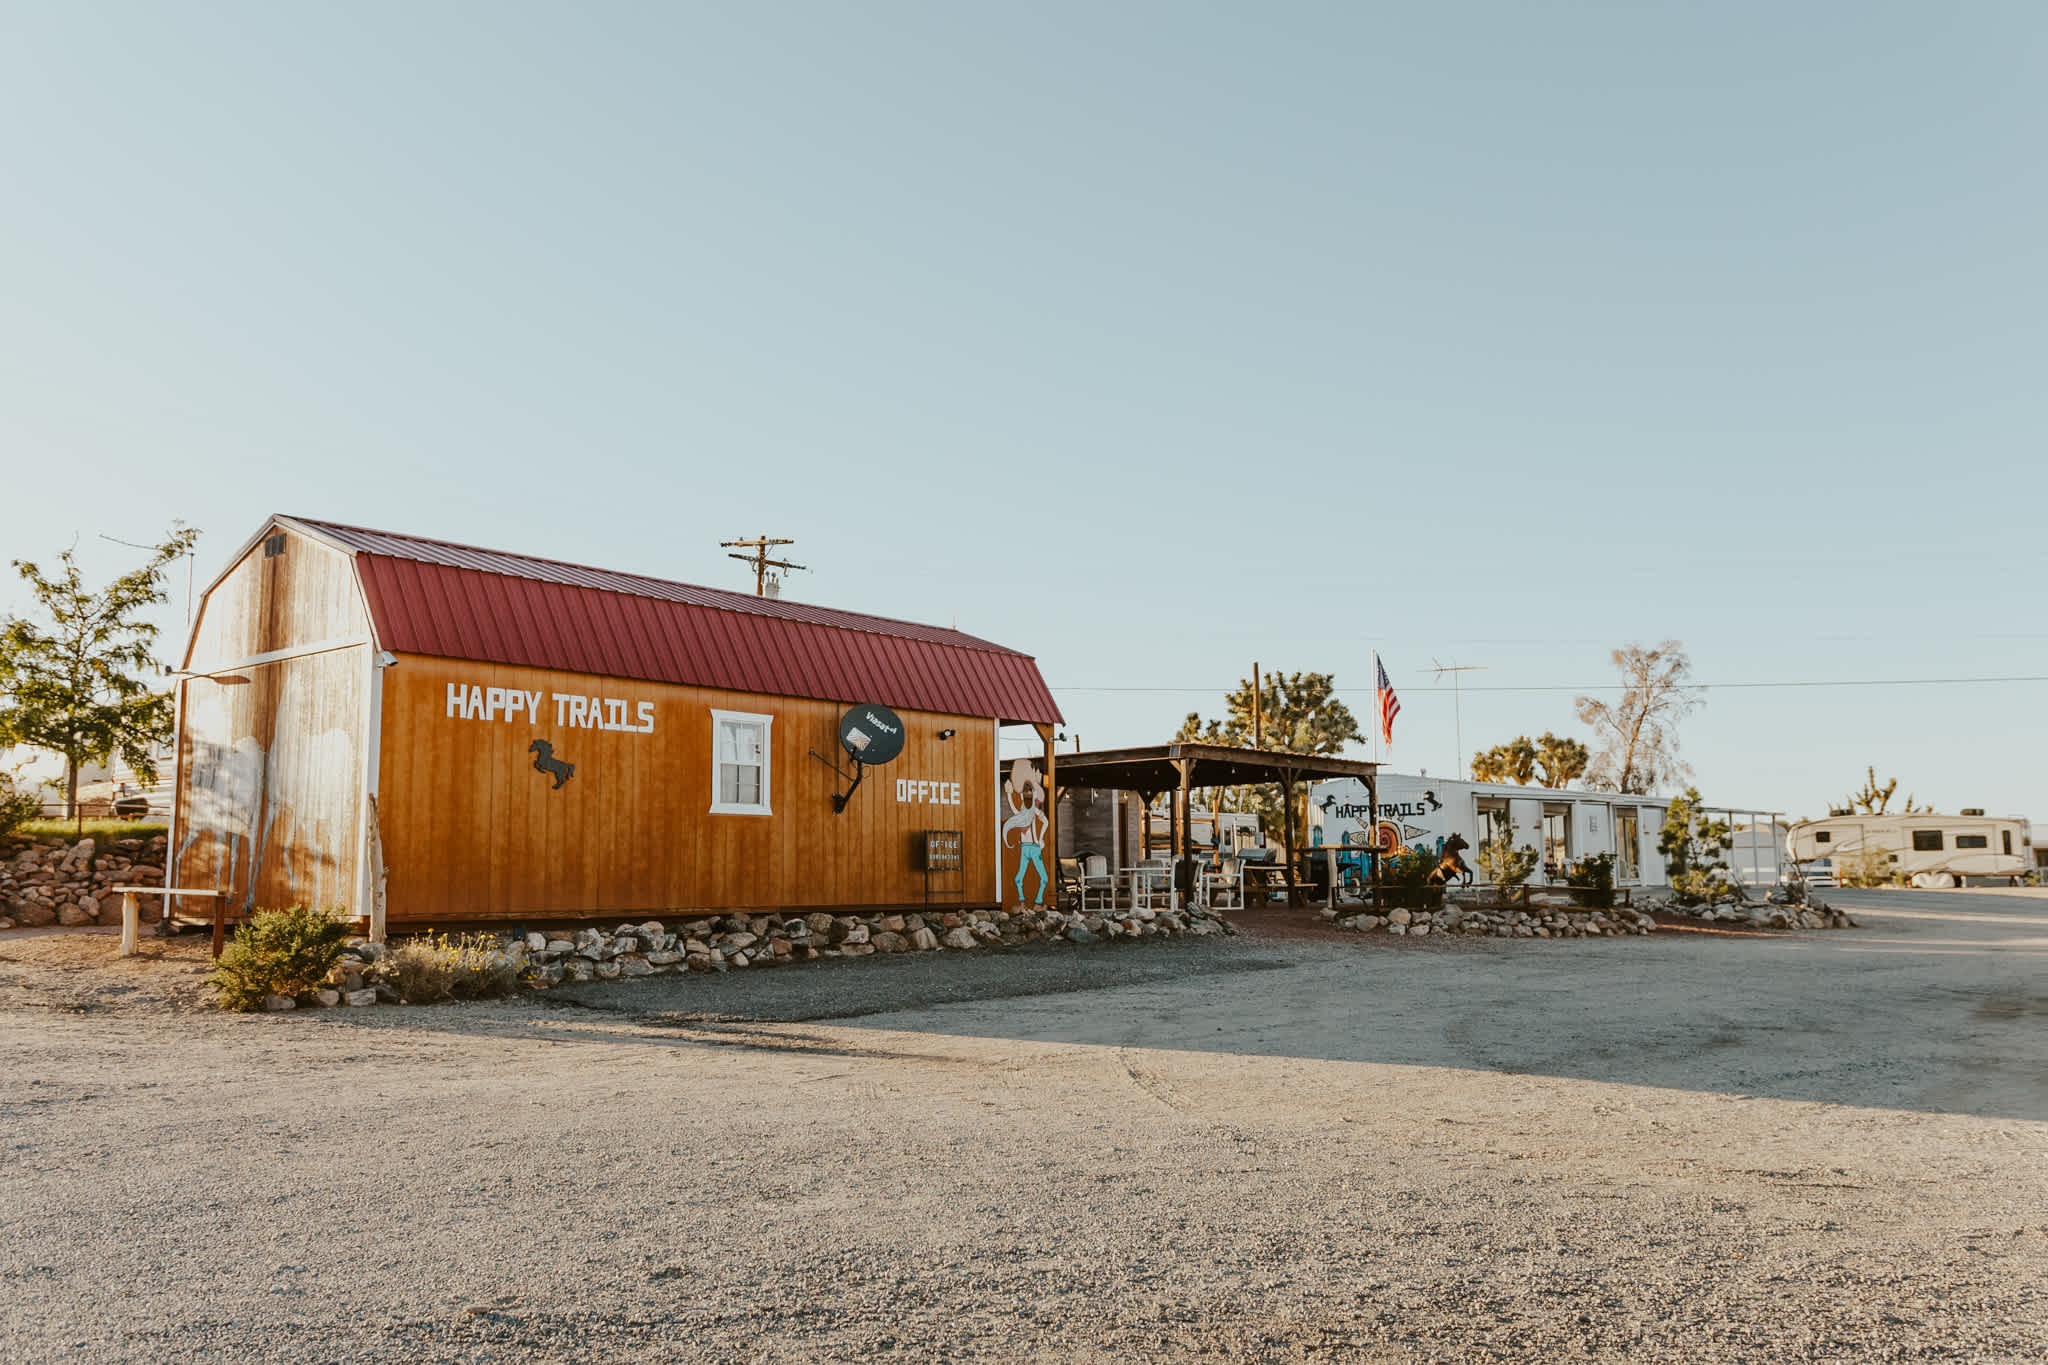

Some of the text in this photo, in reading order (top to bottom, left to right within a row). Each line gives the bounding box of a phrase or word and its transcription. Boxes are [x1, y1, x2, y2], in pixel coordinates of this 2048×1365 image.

[446, 682, 655, 734] HAPPY TRAILS
[866, 711, 890, 733] Viasat
[896, 778, 961, 805] OFFICE
[1335, 802, 1425, 819] HAPP TRAILS
